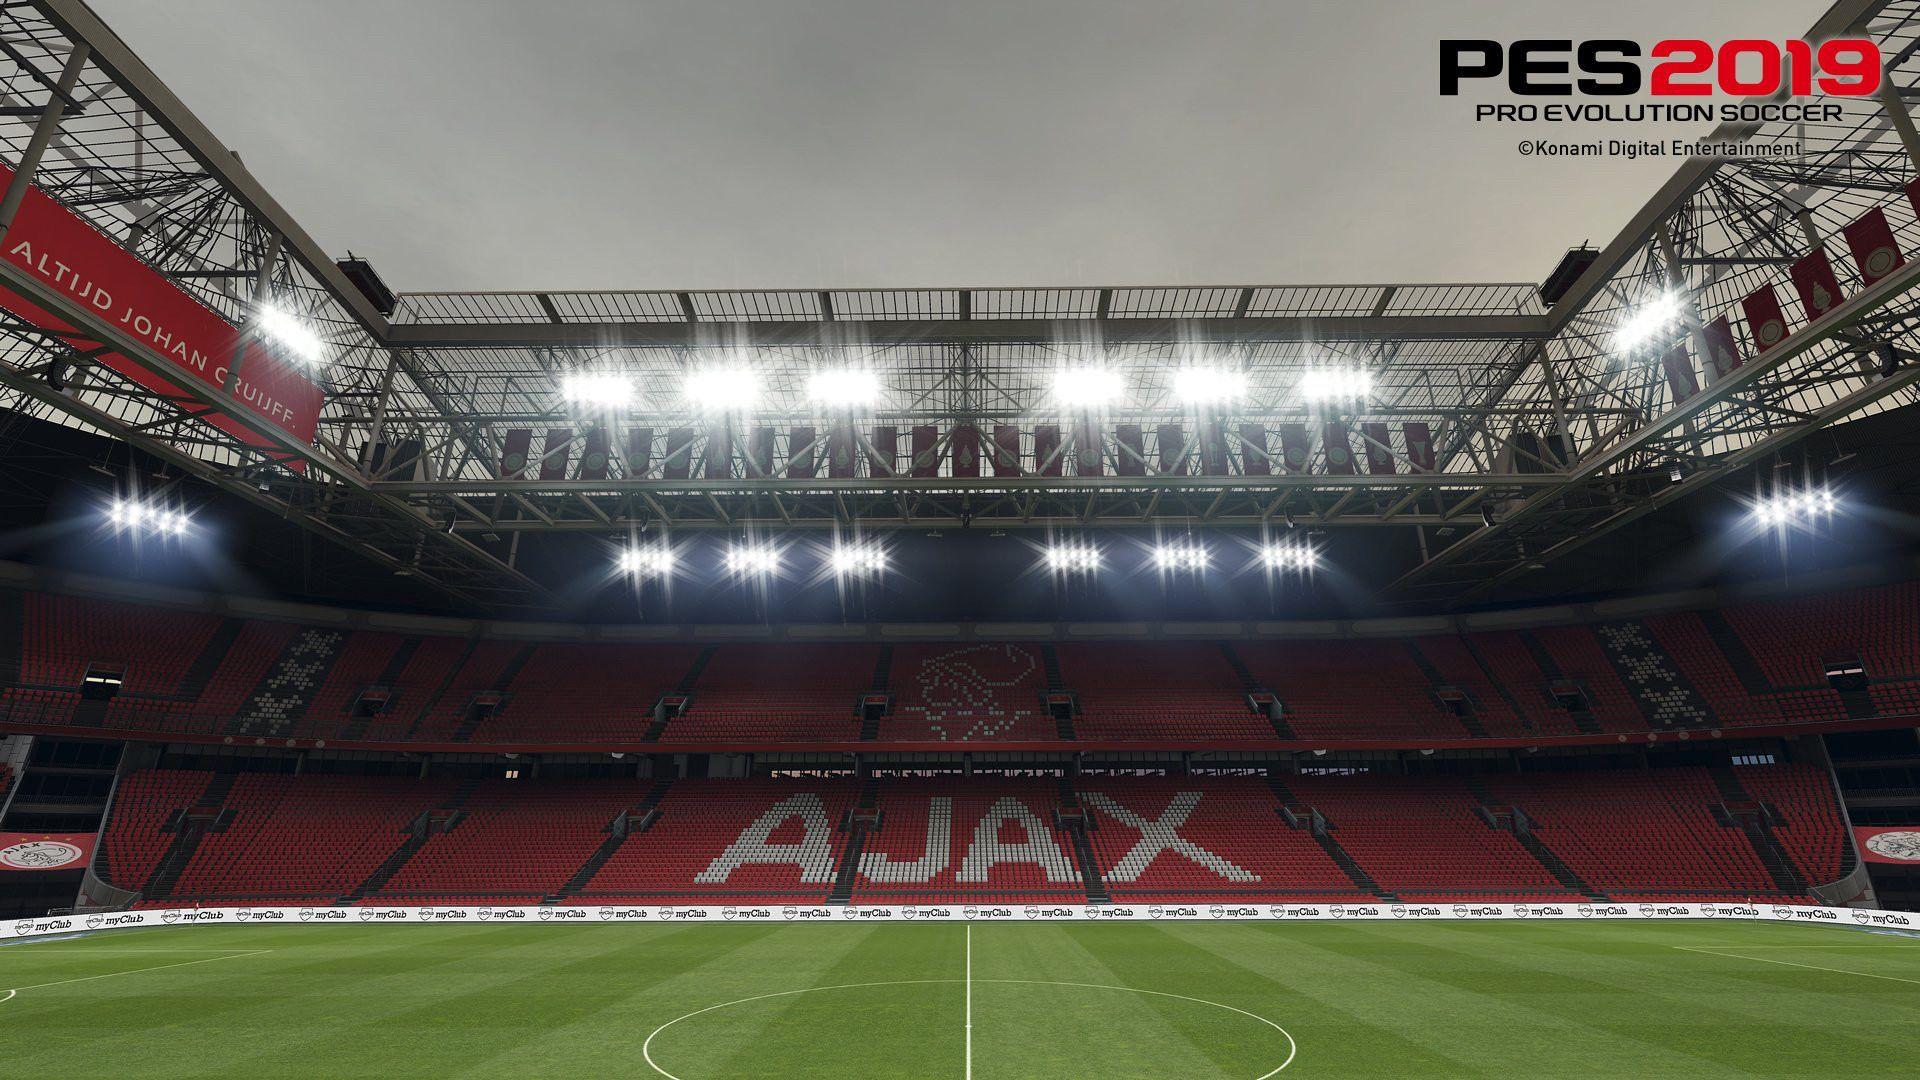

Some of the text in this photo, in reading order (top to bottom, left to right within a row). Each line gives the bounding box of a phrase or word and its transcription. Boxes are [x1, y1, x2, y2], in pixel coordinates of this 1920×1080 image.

[10, 241, 113, 310] ALTIJD
[120, 308, 208, 371] JOHAN
[693, 792, 1262, 883] AJAX
[35, 919, 72, 931] myClub
[105, 914, 144, 925] myClub
[252, 910, 284, 921] myClub
[315, 910, 347, 920] myClub
[376, 909, 406, 920] myClub
[435, 909, 466, 920] myClub
[494, 909, 525, 920] myClub
[555, 909, 586, 920] myClub
[616, 909, 647, 920] myClub
[676, 909, 707, 919] myClub
[739, 909, 770, 919] myClub
[800, 909, 831, 919] myClub
[860, 909, 891, 919] myClub
[919, 909, 950, 919] myClub
[980, 909, 1011, 918] myClub
[1042, 909, 1073, 918] myClub
[1102, 908, 1133, 918] myClub
[1166, 908, 1197, 918] myClub
[1227, 908, 1258, 918] myClub
[1288, 908, 1319, 918] myClub
[1347, 908, 1378, 917] myClub
[1409, 907, 1440, 917] myClub
[1470, 907, 1502, 917] myClub
[1531, 907, 1563, 917] myClub
[1595, 907, 1627, 917] myClub
[1657, 907, 1689, 917] myClub
[1796, 909, 1837, 920] myClub
[1872, 914, 1910, 925] myClub
